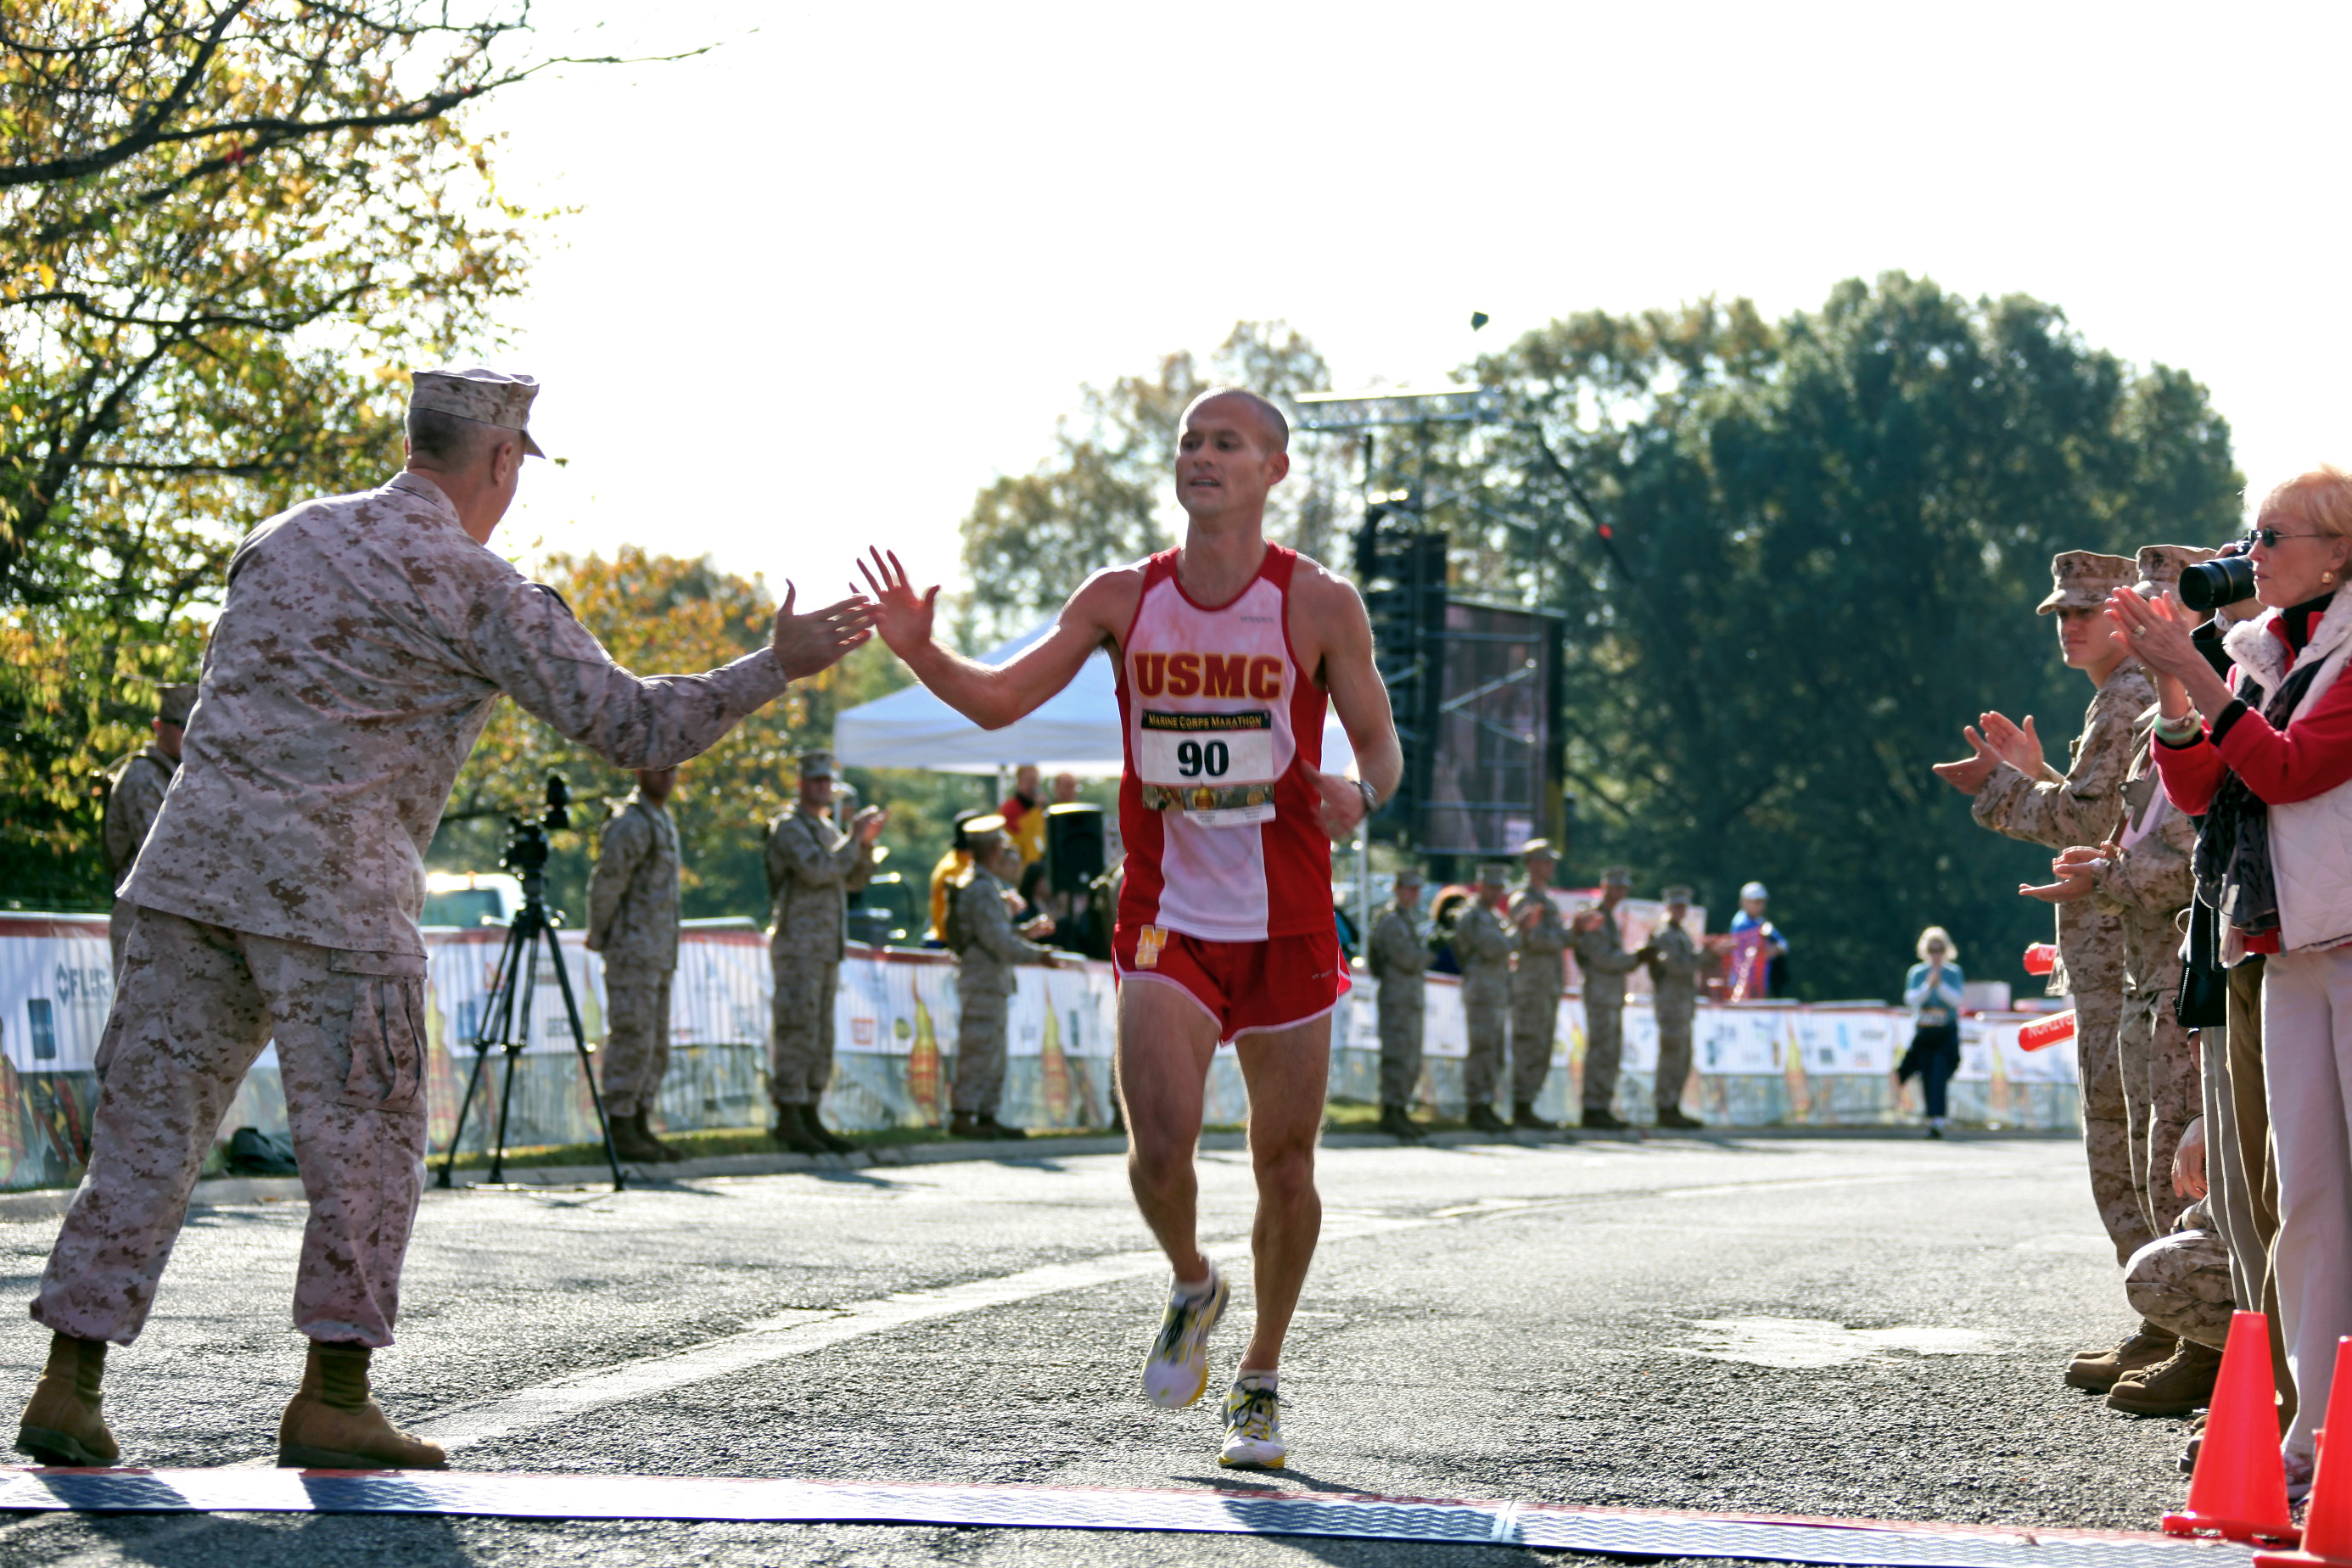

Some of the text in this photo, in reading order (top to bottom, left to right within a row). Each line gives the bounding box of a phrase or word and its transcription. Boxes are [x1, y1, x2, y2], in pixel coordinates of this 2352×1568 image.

[1134, 652, 1284, 700] USMC
[1148, 714, 1262, 729] MARINE CORPS MARATHON
[1177, 739, 1229, 777] 90
[68, 968, 109, 998] FLIR
